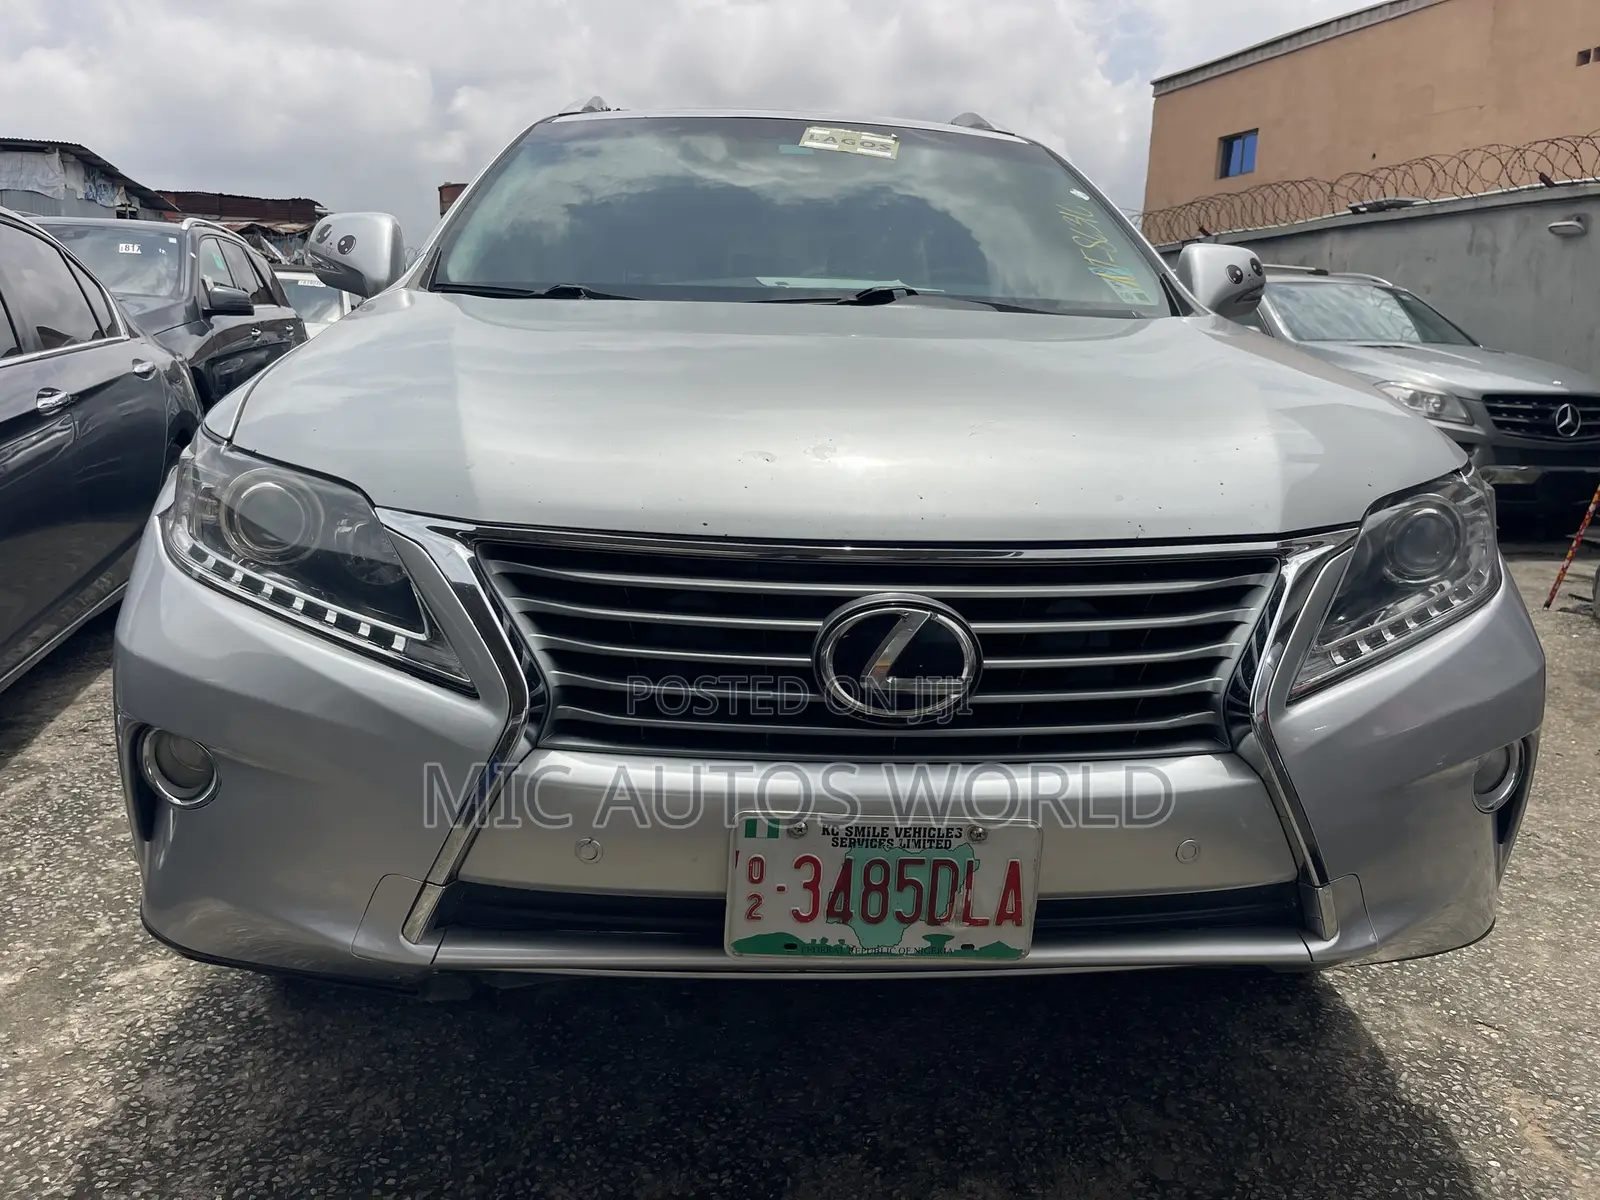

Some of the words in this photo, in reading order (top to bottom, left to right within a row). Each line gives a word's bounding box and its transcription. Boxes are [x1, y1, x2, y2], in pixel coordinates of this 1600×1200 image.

[808, 133, 892, 151] LAGOS
[821, 825, 840, 837] KC
[845, 826, 890, 838] SMILE
[894, 827, 963, 839] VEHICLES
[831, 837, 895, 849] SERVICES
[899, 839, 952, 850] LIMITED
[849, 946, 896, 956] REPUBLIC
[898, 946, 912, 956] OF
[914, 946, 954, 956] NIGERIA
